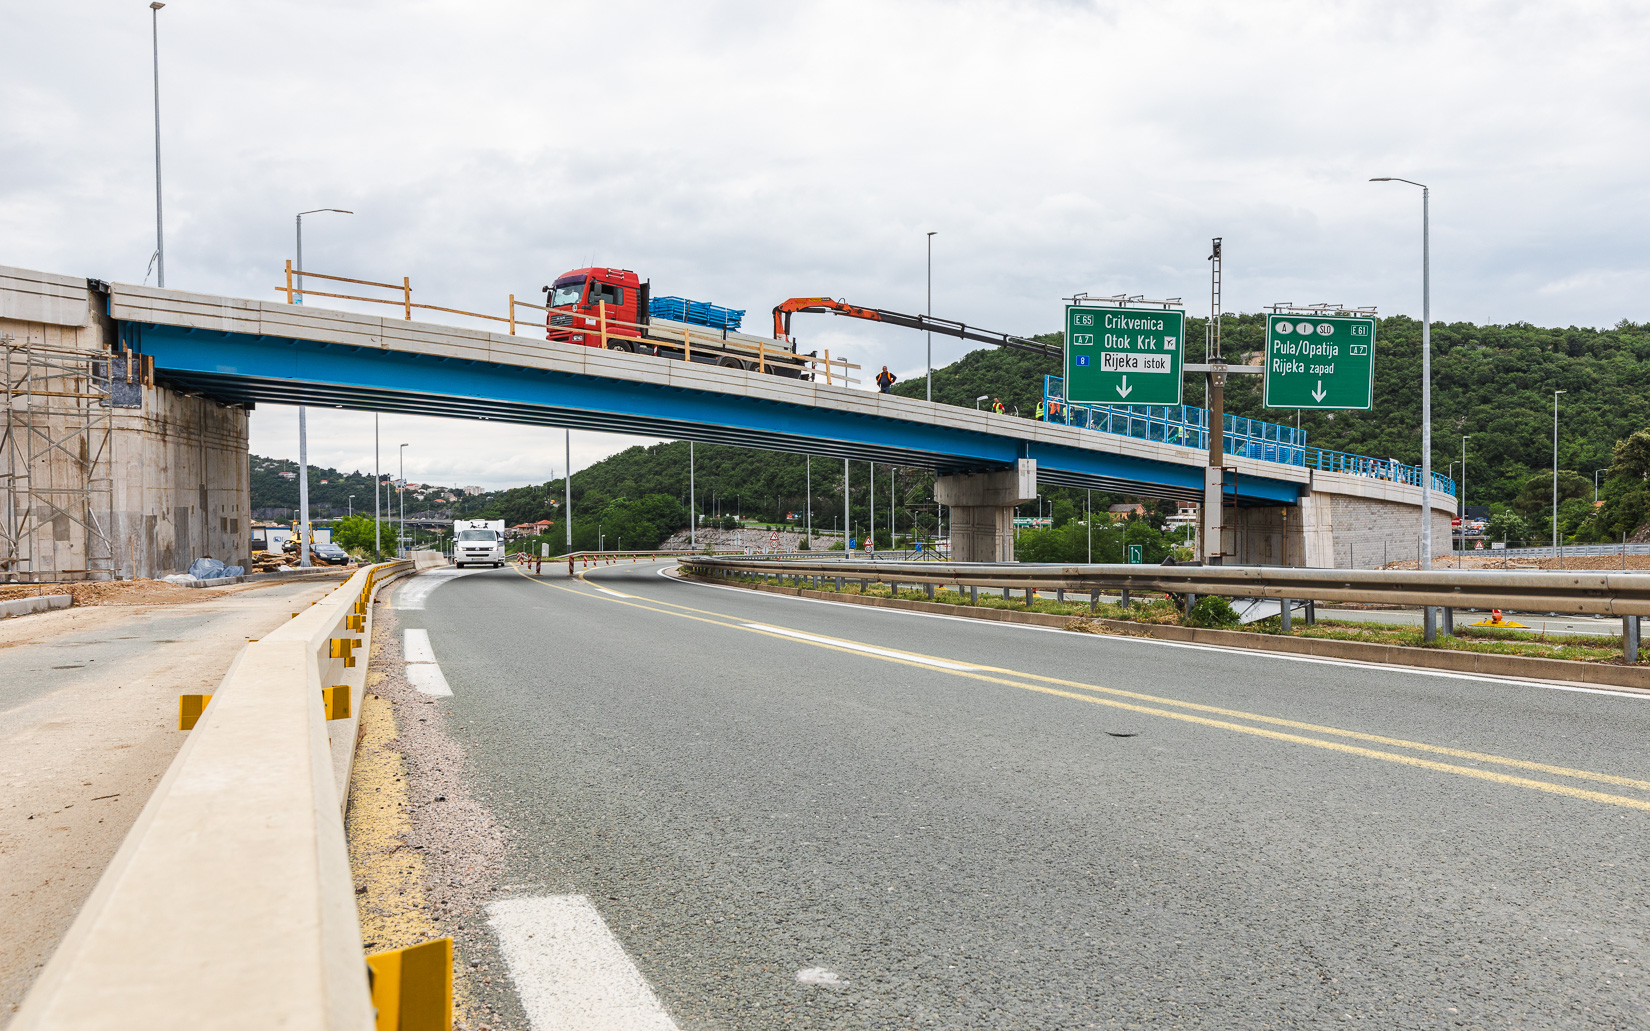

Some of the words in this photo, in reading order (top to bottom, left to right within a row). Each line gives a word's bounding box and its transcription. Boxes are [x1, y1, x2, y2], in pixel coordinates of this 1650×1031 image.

[1076, 315, 1080, 324] E
[1083, 315, 1092, 325] 65
[1105, 314, 1164, 331] Crikvenica
[1282, 324, 1287, 332] A
[1320, 325, 1332, 334] SLO
[1352, 326, 1356, 334] E
[1358, 326, 1366, 335] 61
[1078, 336, 1083, 344] A
[1084, 336, 1090, 344] 7
[1104, 333, 1131, 349] Otok
[1137, 335, 1157, 350] Krk
[1273, 340, 1339, 359] Pula/Opatija
[1104, 353, 1138, 371] Rijeka
[1144, 357, 1166, 369] istok
[1272, 358, 1305, 376] Rijeka
[1309, 362, 1335, 377] zapad
